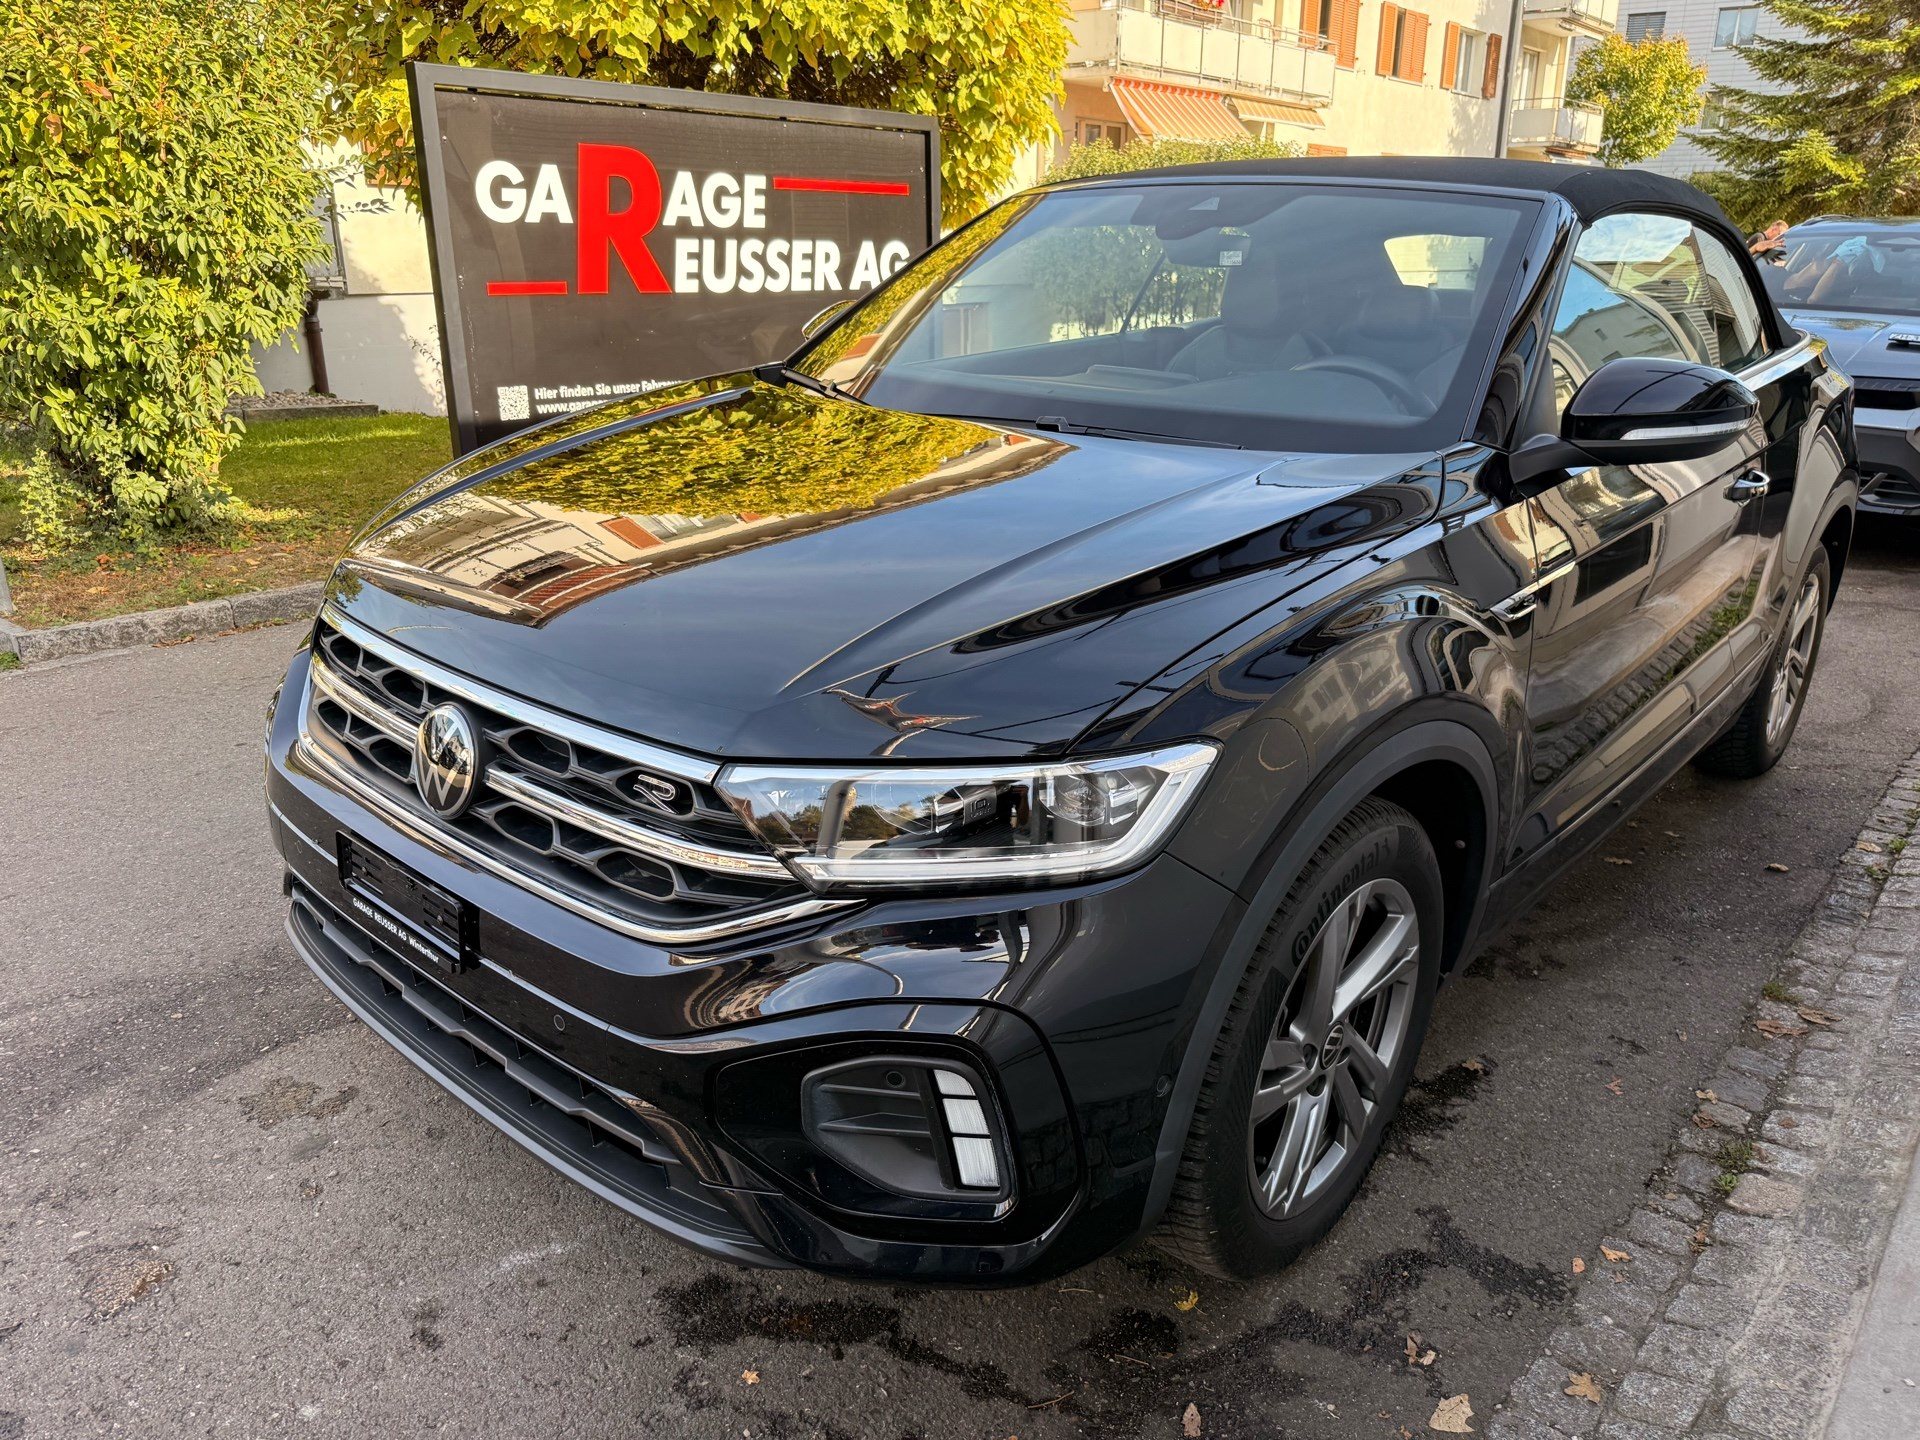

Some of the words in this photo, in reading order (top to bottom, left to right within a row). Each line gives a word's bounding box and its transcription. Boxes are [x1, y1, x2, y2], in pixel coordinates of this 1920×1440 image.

[475, 142, 767, 294] GARAGE
[848, 239, 910, 290] AG
[534, 387, 558, 400] Hier
[560, 384, 594, 398] finden
[595, 383, 612, 396] Sie
[612, 383, 641, 394] unser
[352, 897, 374, 919] GARAGE
[374, 911, 398, 935] REUSSER
[398, 928, 407, 941] AG
[408, 935, 439, 963] Winterthur
